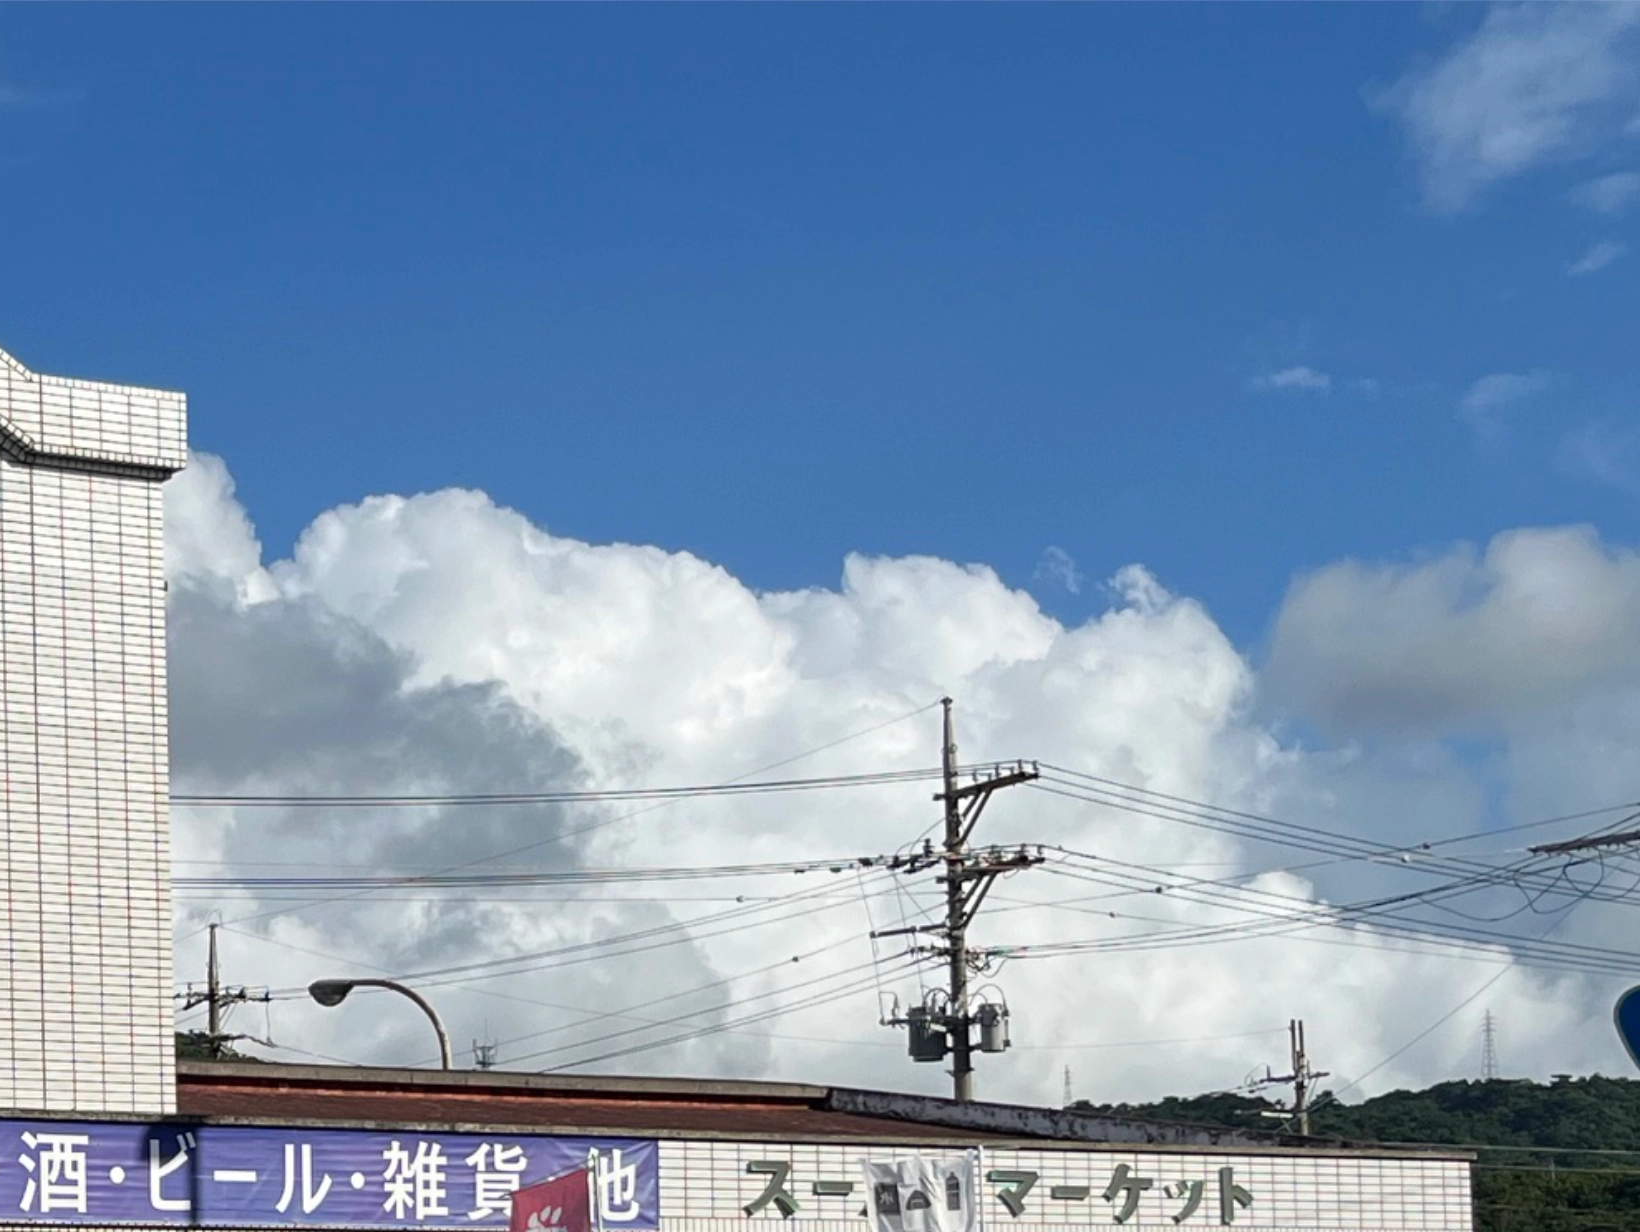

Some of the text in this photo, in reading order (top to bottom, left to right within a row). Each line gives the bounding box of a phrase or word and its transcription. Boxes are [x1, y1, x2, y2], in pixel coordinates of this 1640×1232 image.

[743, 1159, 1255, 1226] スーマーケット
